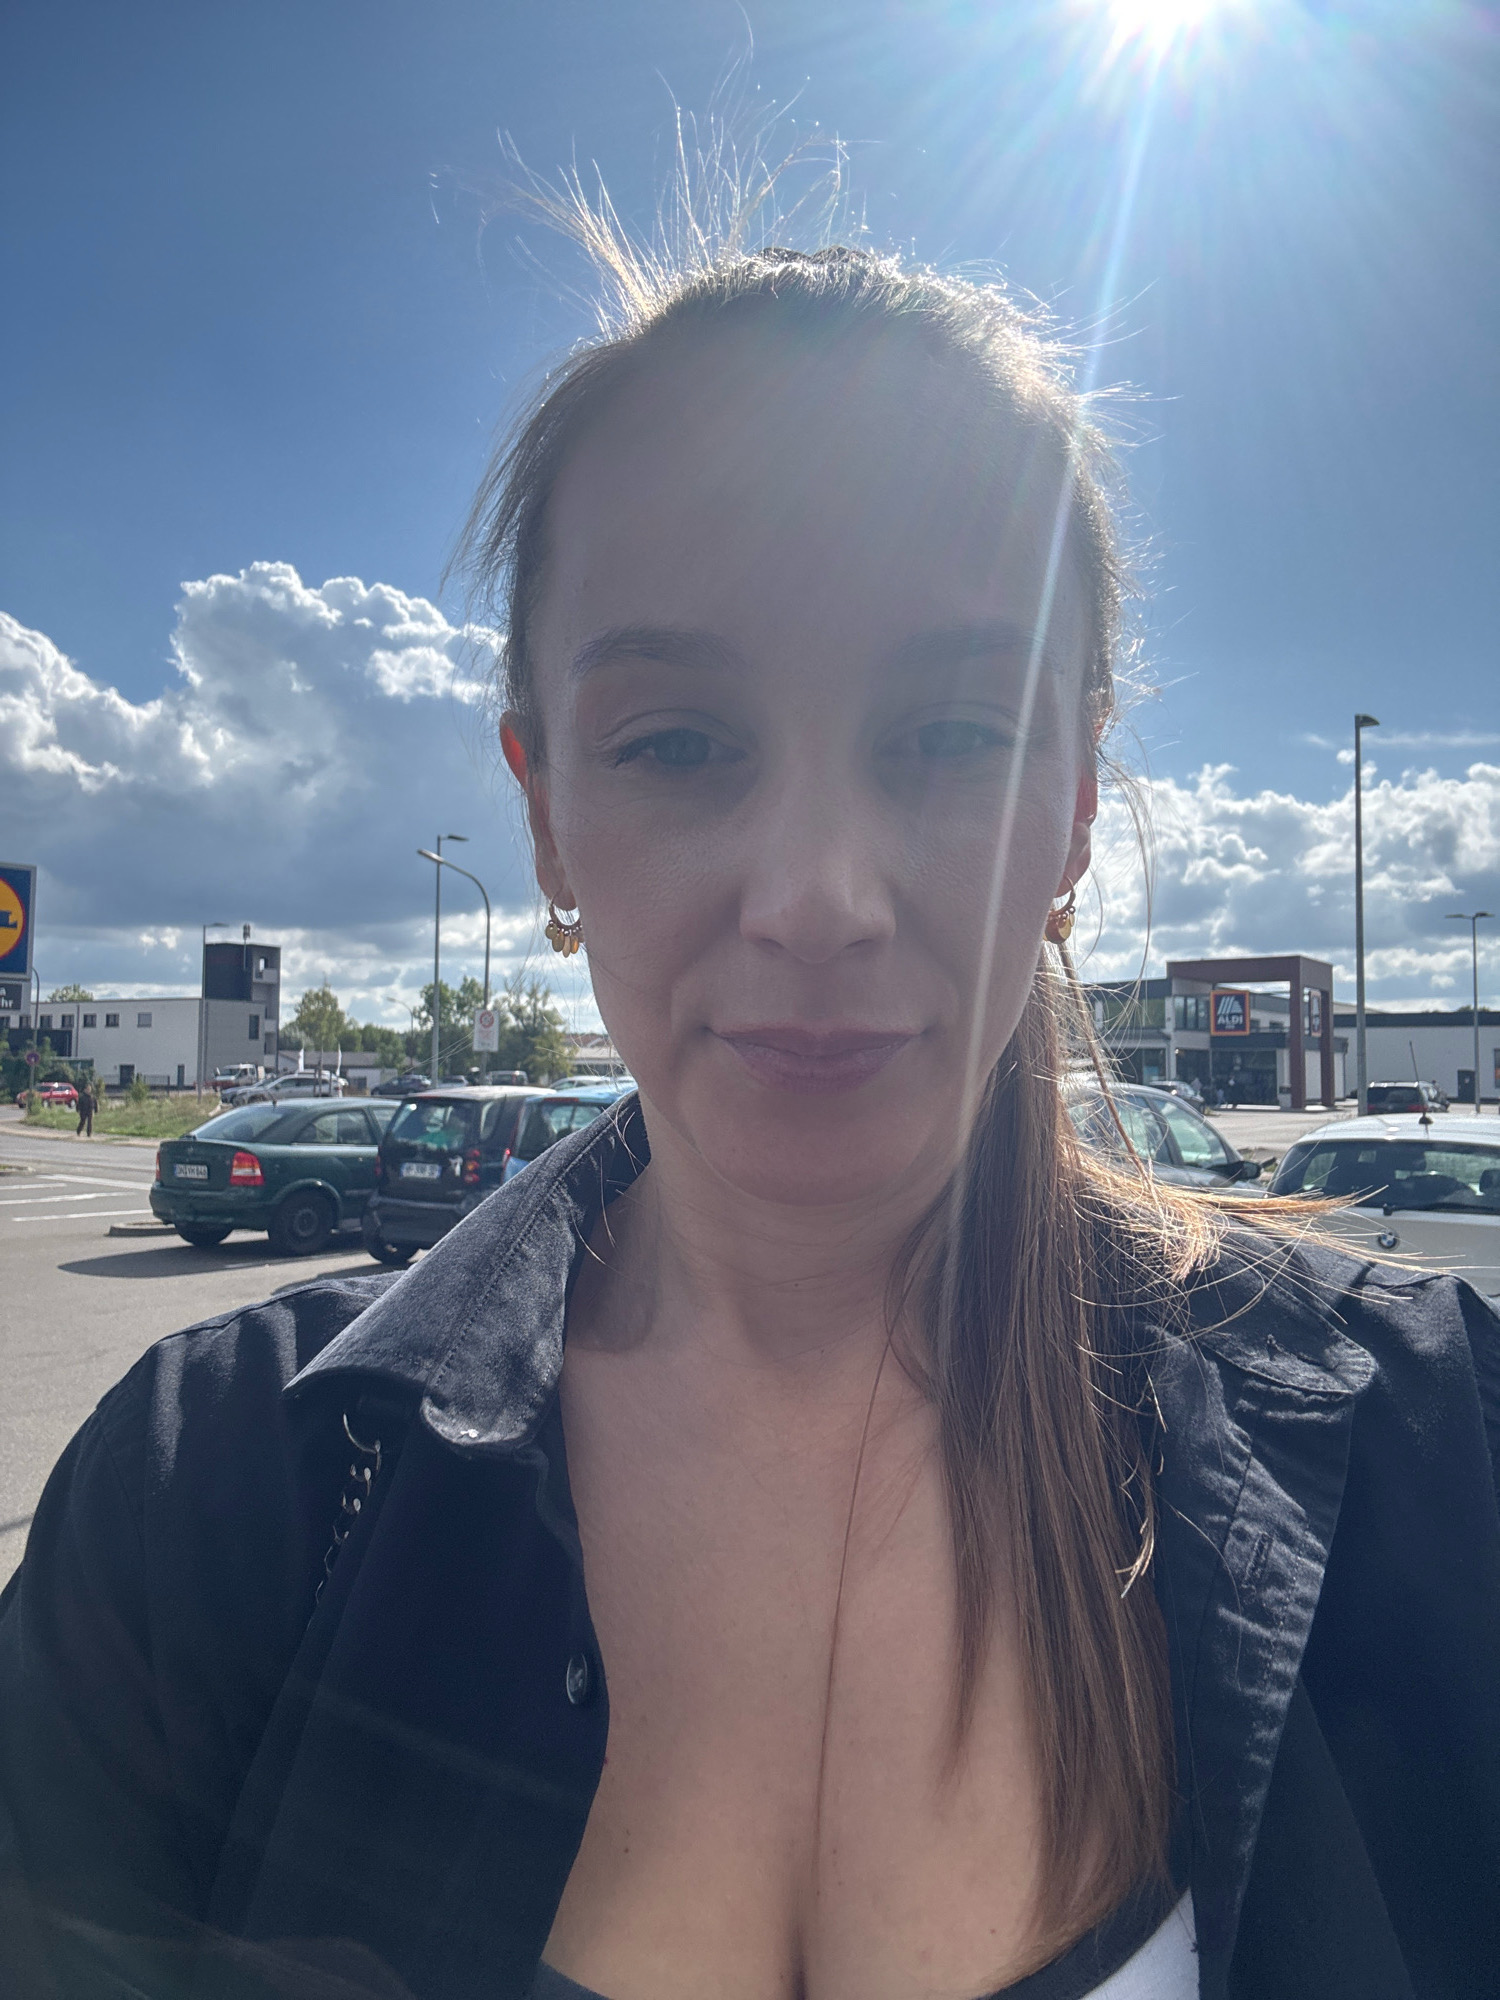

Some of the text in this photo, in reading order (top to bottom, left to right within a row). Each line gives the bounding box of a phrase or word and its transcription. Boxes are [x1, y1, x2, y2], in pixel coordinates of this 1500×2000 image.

[0, 910, 17, 929] L
[0, 997, 14, 1008] hr
[1217, 1015, 1243, 1024] ALDI
